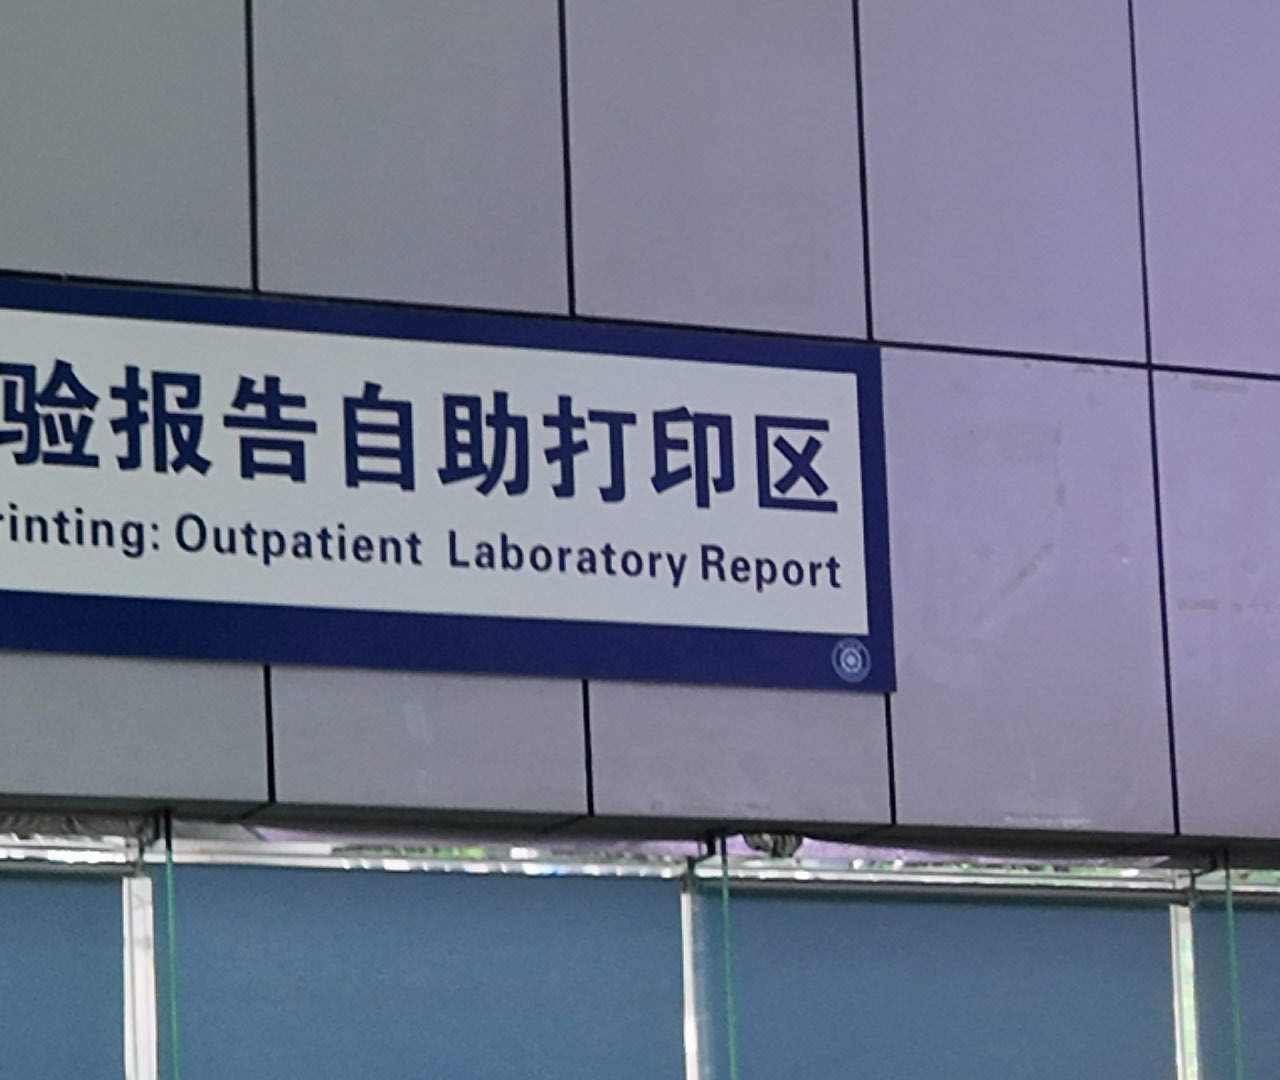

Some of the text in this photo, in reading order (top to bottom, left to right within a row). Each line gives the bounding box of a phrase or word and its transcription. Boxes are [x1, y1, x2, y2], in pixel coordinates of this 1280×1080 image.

[176, 514, 422, 566] Outpatient
[449, 530, 686, 588] Laboratory
[701, 545, 840, 592] Report
